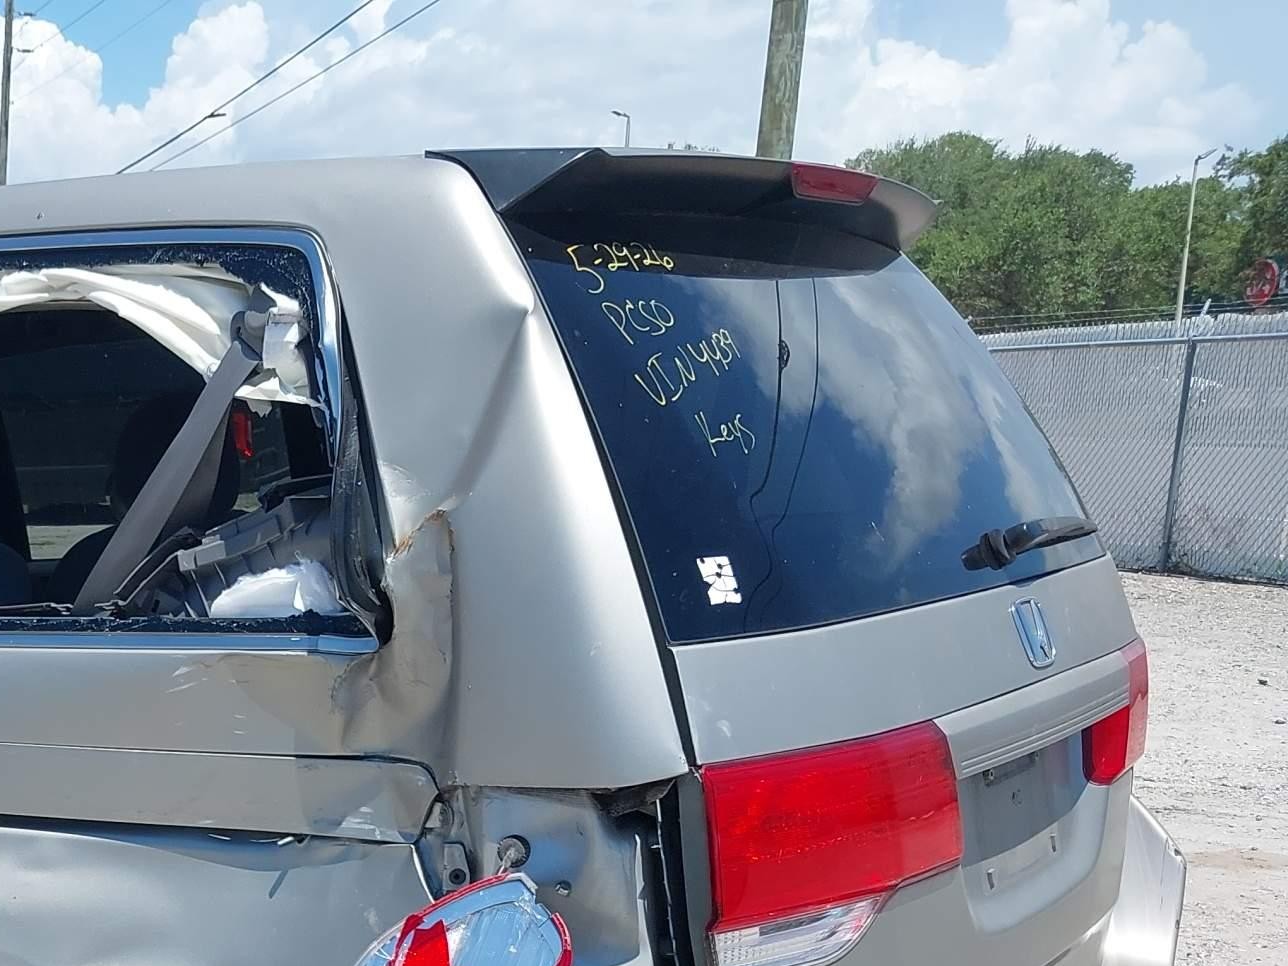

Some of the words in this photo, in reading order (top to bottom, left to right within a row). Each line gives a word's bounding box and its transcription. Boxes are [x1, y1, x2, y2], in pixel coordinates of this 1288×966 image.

[566, 242, 674, 294] 5-29-26
[601, 299, 674, 345] PCSO
[694, 411, 756, 457] Keys
